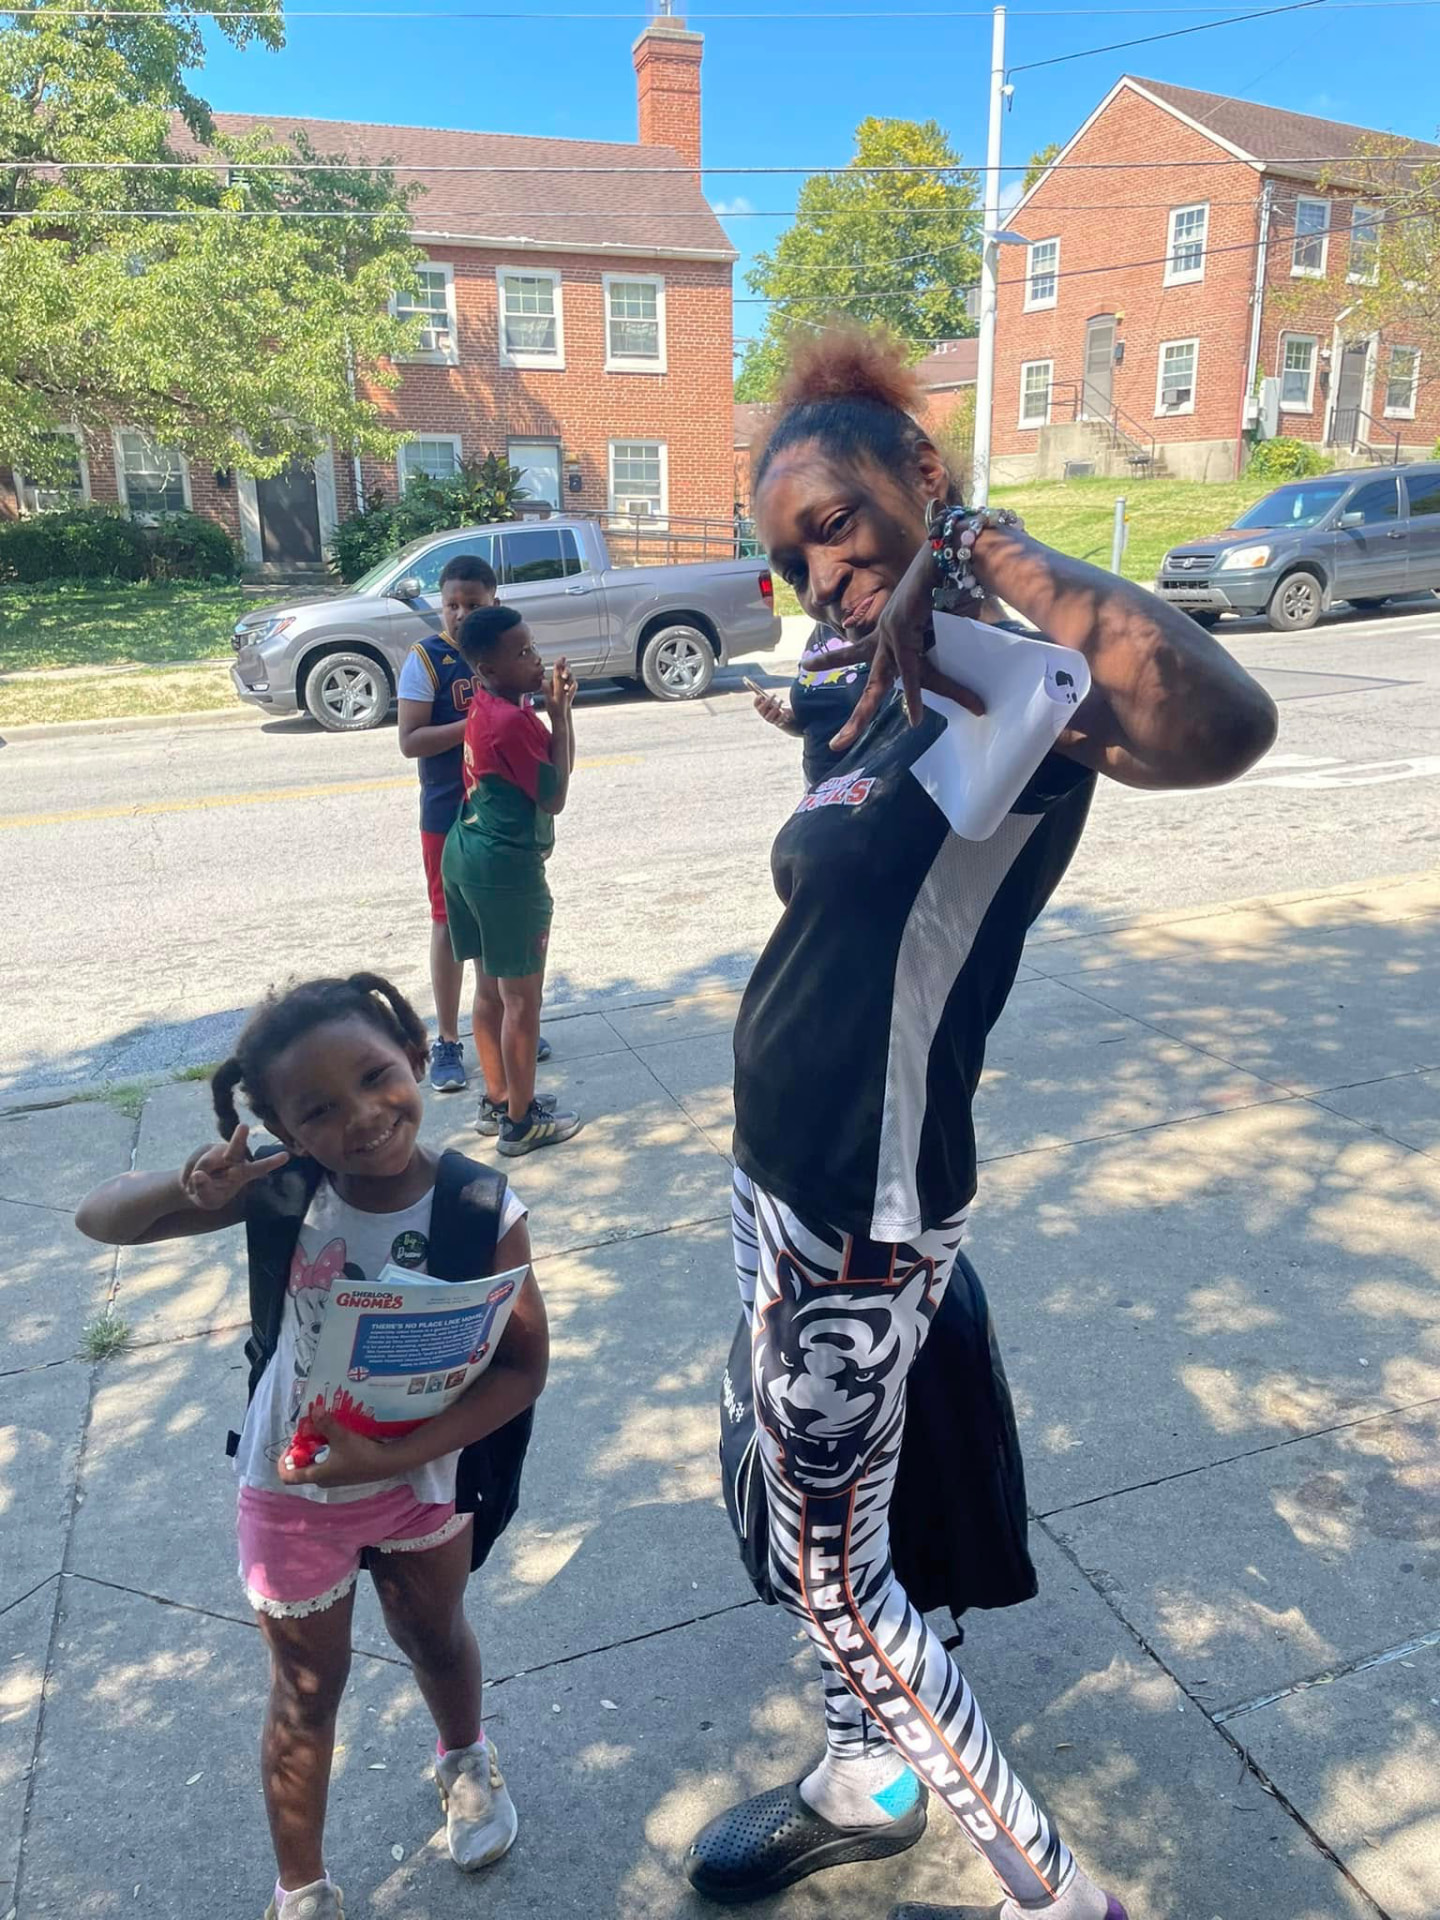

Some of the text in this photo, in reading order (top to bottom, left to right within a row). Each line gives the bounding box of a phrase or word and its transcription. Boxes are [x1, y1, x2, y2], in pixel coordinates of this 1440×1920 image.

[335, 1292, 404, 1310] GNOMES
[351, 1290, 394, 1299] SHERLOCK
[405, 1322, 417, 1330] NO
[418, 1320, 443, 1329] PLACE
[808, 1524, 999, 1842] CINCINNATI
